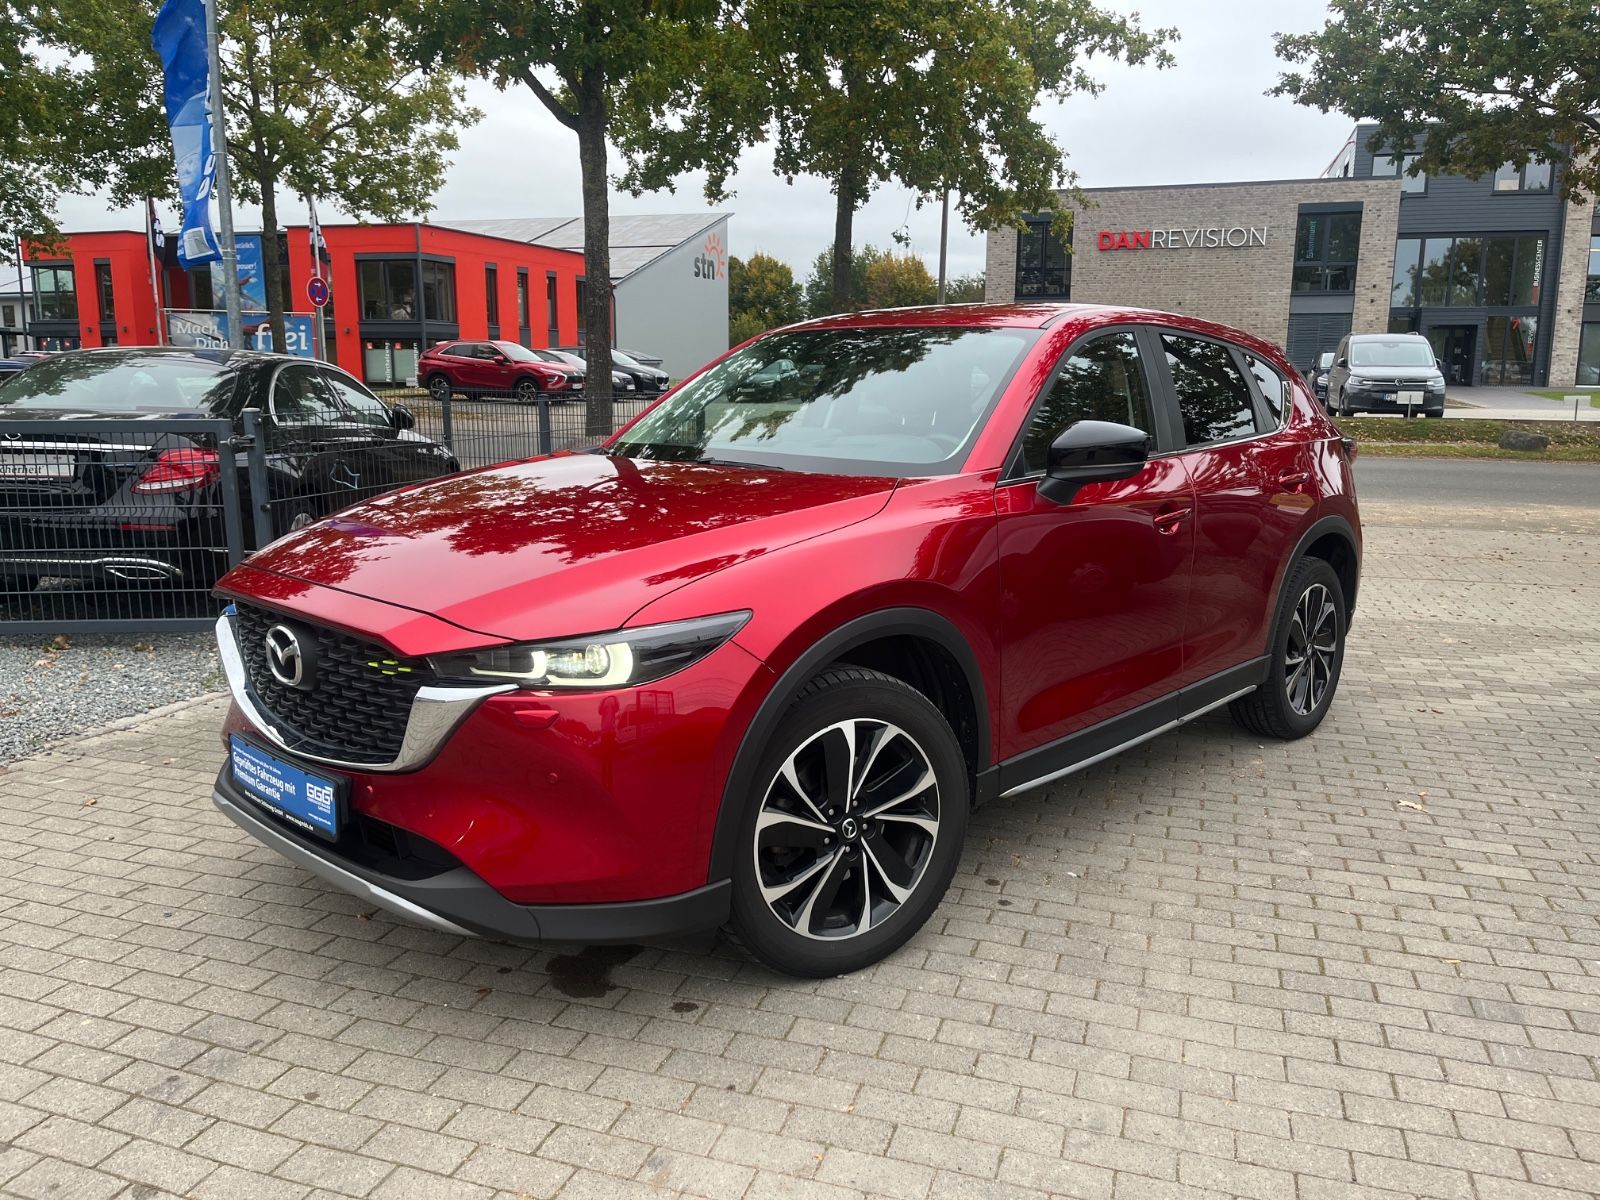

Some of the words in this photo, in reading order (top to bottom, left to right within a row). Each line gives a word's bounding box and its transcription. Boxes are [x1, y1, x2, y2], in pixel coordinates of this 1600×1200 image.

[1097, 226, 1267, 251] DANREVISION
[694, 253, 715, 280] stn
[176, 322, 218, 334] Mach
[255, 324, 307, 351] fei
[195, 337, 229, 349] Dich
[234, 763, 256, 787] Premium
[256, 778, 281, 801] Garantie
[257, 765, 284, 792] Fahrzeug
[284, 782, 296, 796] mit
